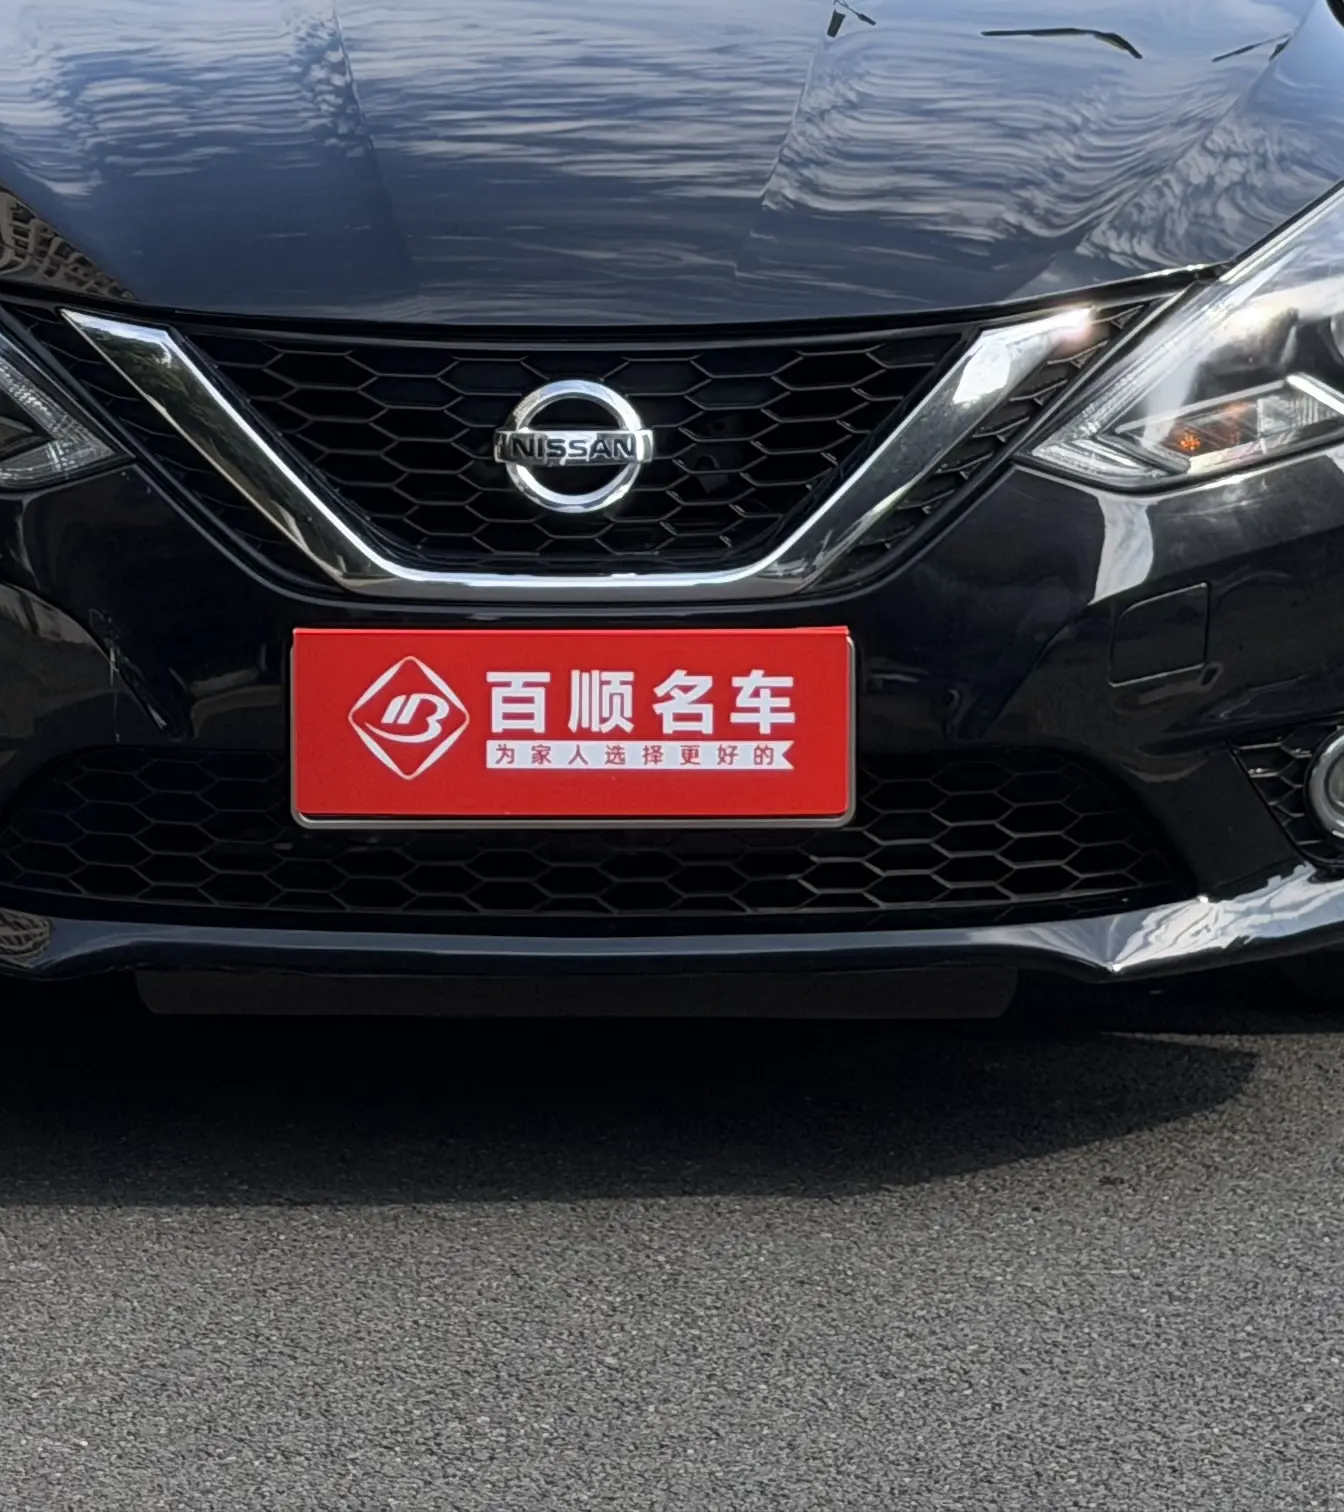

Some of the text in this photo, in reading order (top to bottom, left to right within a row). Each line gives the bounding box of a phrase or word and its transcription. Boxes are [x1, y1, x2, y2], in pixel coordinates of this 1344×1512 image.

[510, 437, 637, 460] NISSAN
[486, 669, 796, 735] 百顺名车
[494, 743, 775, 767] 为家人选择更好的
